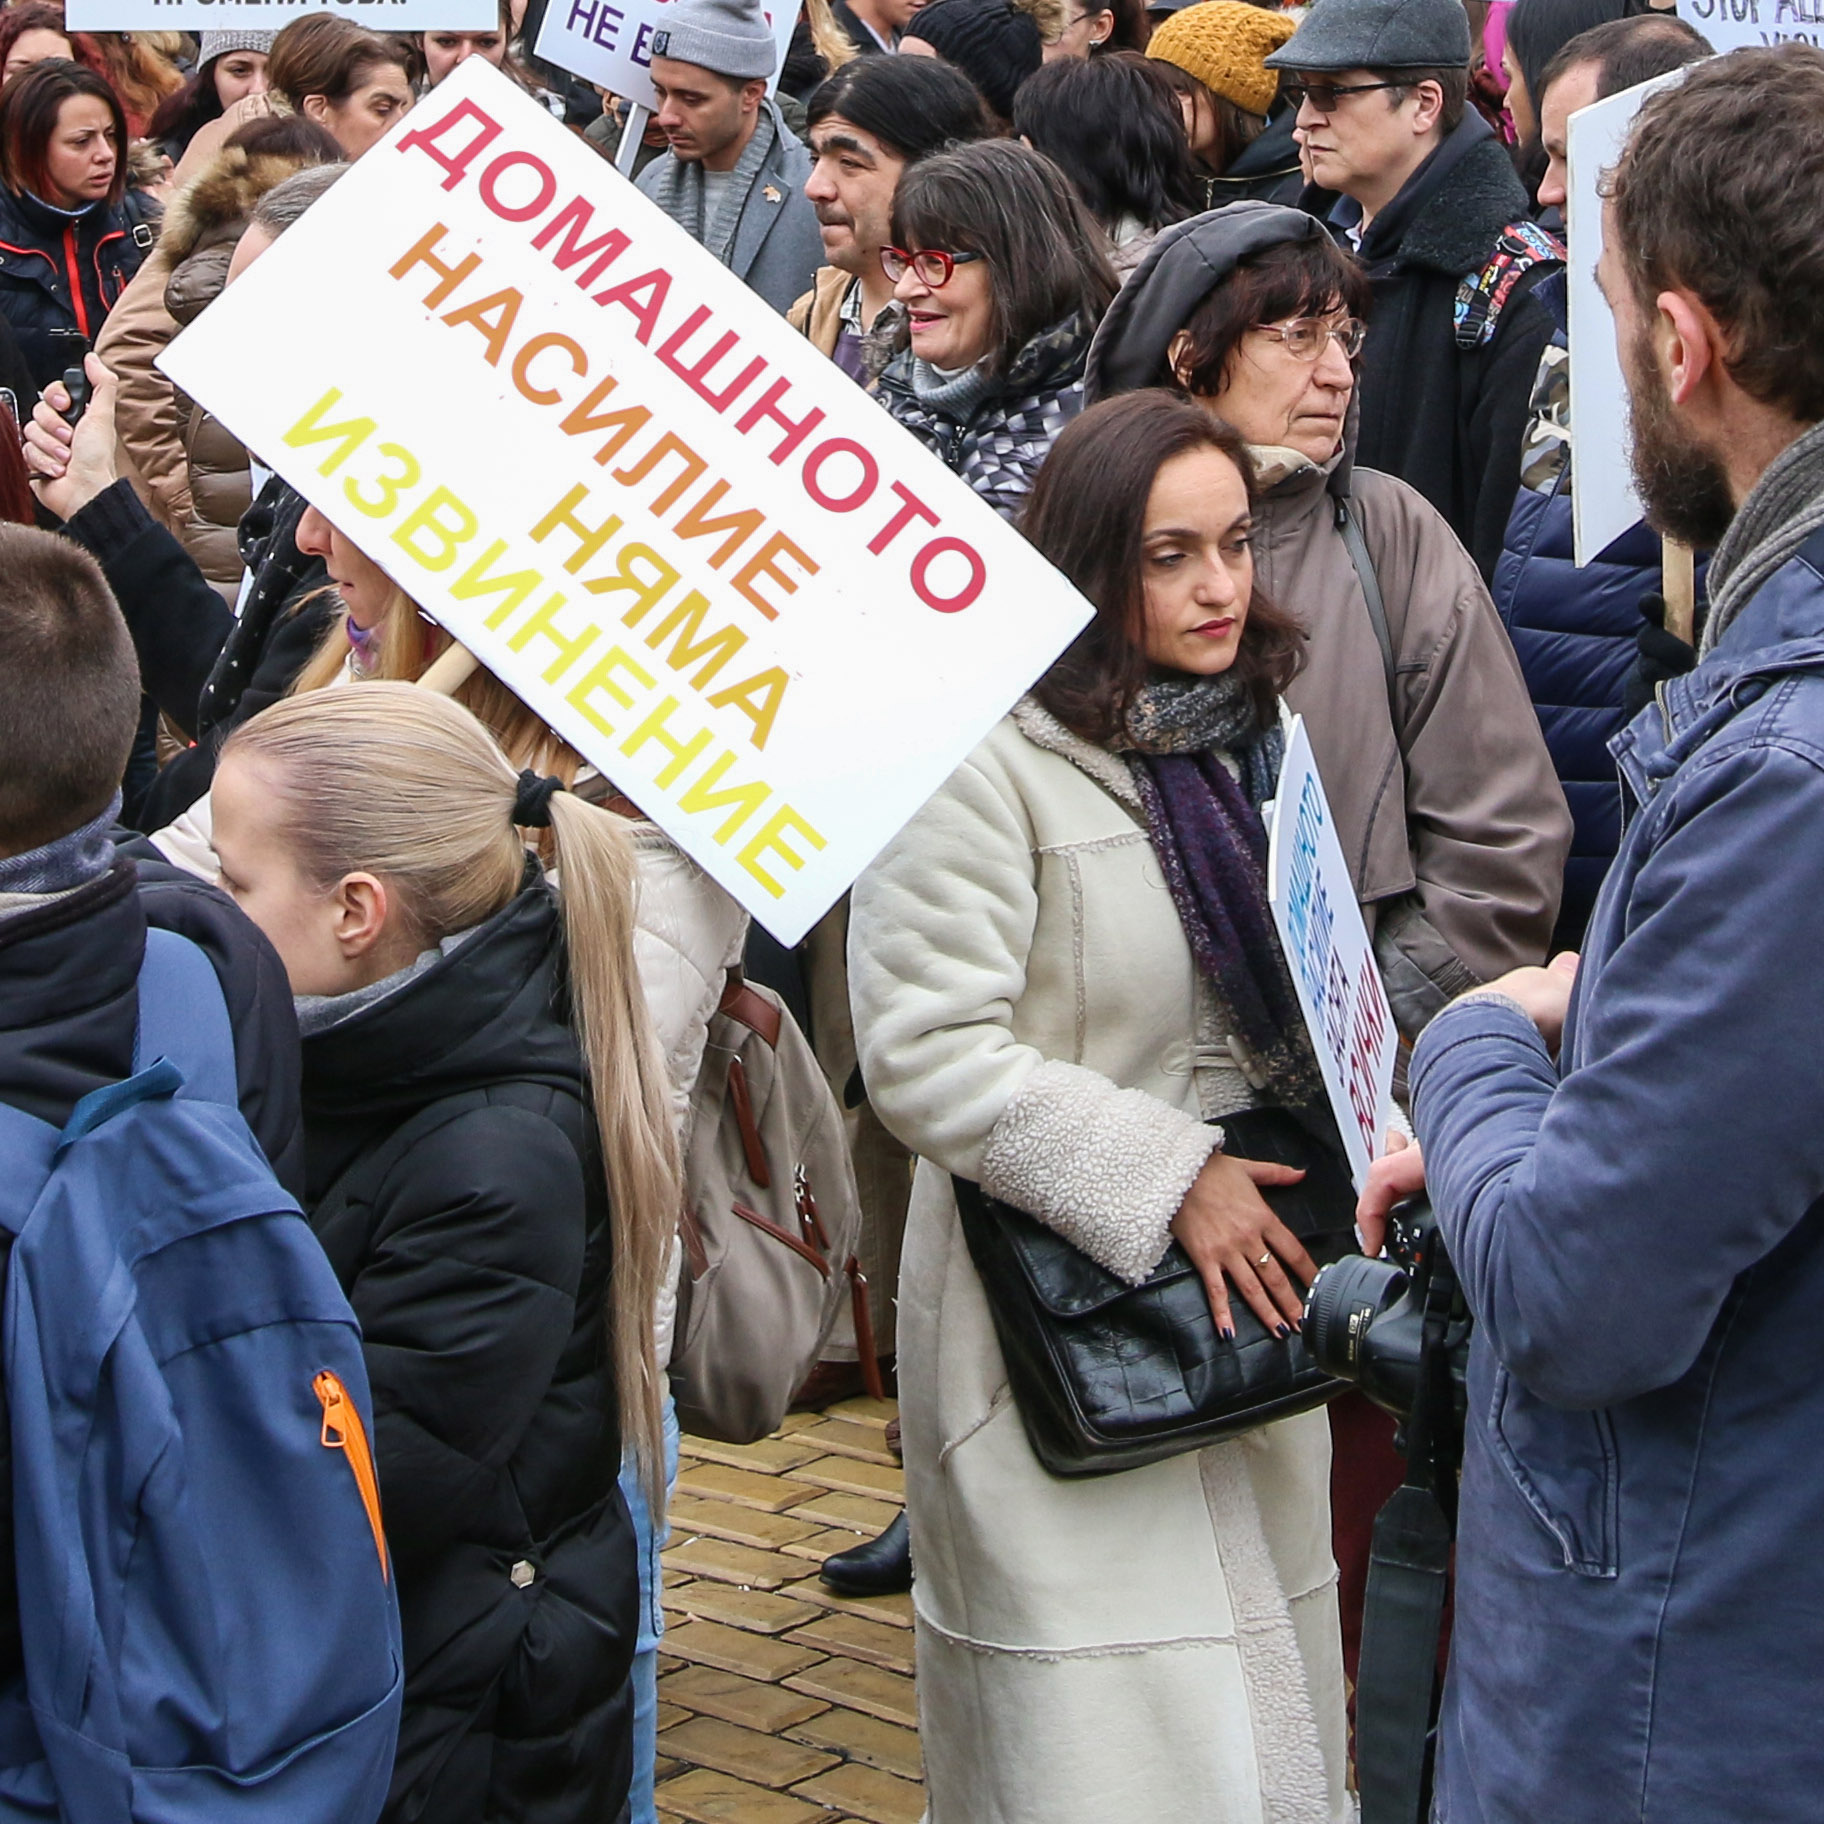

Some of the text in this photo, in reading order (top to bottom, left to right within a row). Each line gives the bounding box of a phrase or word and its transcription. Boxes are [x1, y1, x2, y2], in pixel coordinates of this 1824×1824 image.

[387, 222, 821, 622] НАСИЛИЕ
[395, 96, 987, 614] ДОМАШНОТО
[282, 386, 829, 901] ИЗВИНЕНИЕ
[528, 481, 793, 753] НЯМА
[1325, 945, 1350, 1091] ЗАСЯГА
[1350, 947, 1387, 1162] ВСИЧКИ
